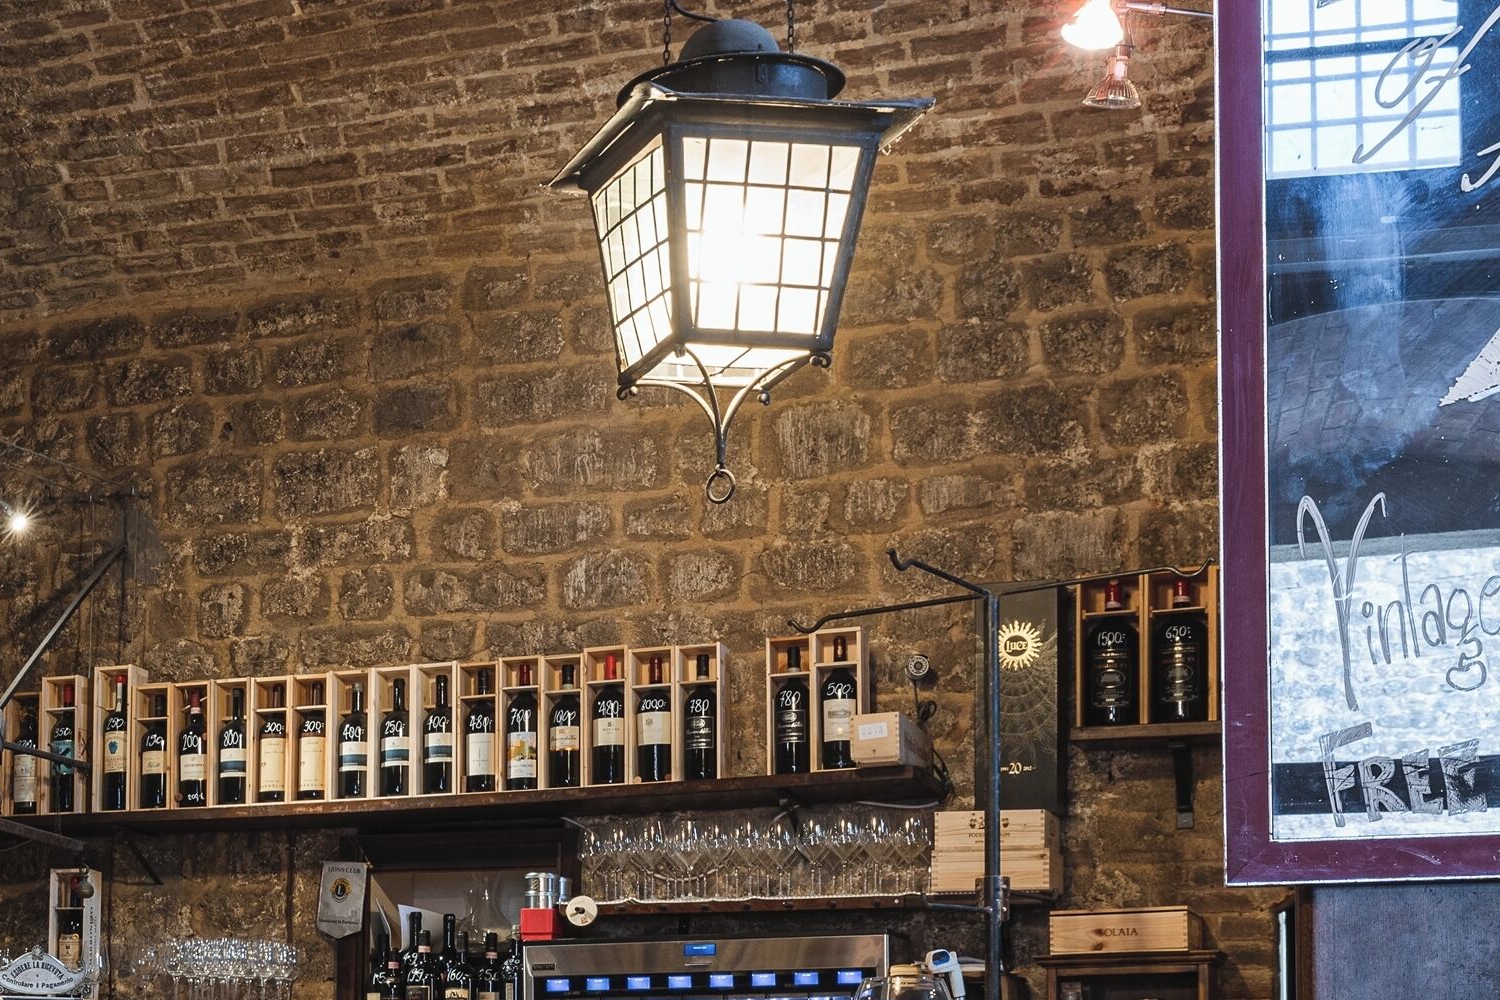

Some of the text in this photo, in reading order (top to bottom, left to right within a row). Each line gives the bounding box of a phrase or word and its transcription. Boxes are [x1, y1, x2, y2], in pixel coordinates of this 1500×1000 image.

[1006, 640, 1029, 652] LUCE
[1009, 762, 1022, 775] 20
[1320, 722, 1487, 827] FREE
[1098, 927, 1139, 937] SOLAIA
[32, 961, 41, 969] LA
[41, 962, 65, 981] RICEVUTA
[1, 974, 34, 989] Controllare
[41, 976, 74, 989] Pagamento
